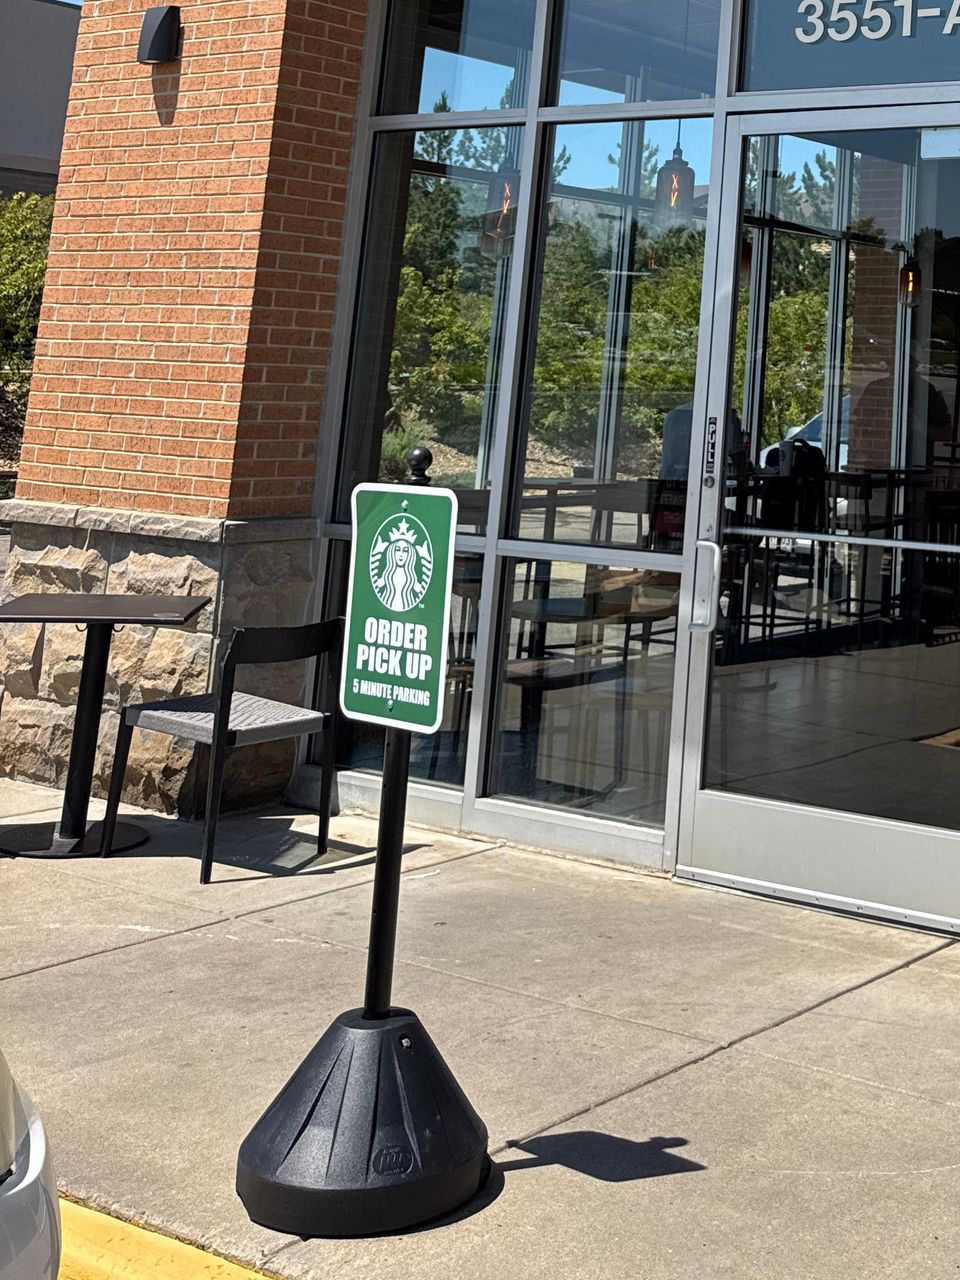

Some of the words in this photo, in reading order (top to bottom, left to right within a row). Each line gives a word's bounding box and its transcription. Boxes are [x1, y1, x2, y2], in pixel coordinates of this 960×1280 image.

[707, 424, 716, 462] PULL
[364, 616, 428, 651] ORDER
[356, 643, 403, 677] PICK
[405, 651, 433, 681] UP
[352, 678, 360, 694] 5
[360, 679, 392, 699] MINUTE
[392, 685, 431, 706] PARKING
